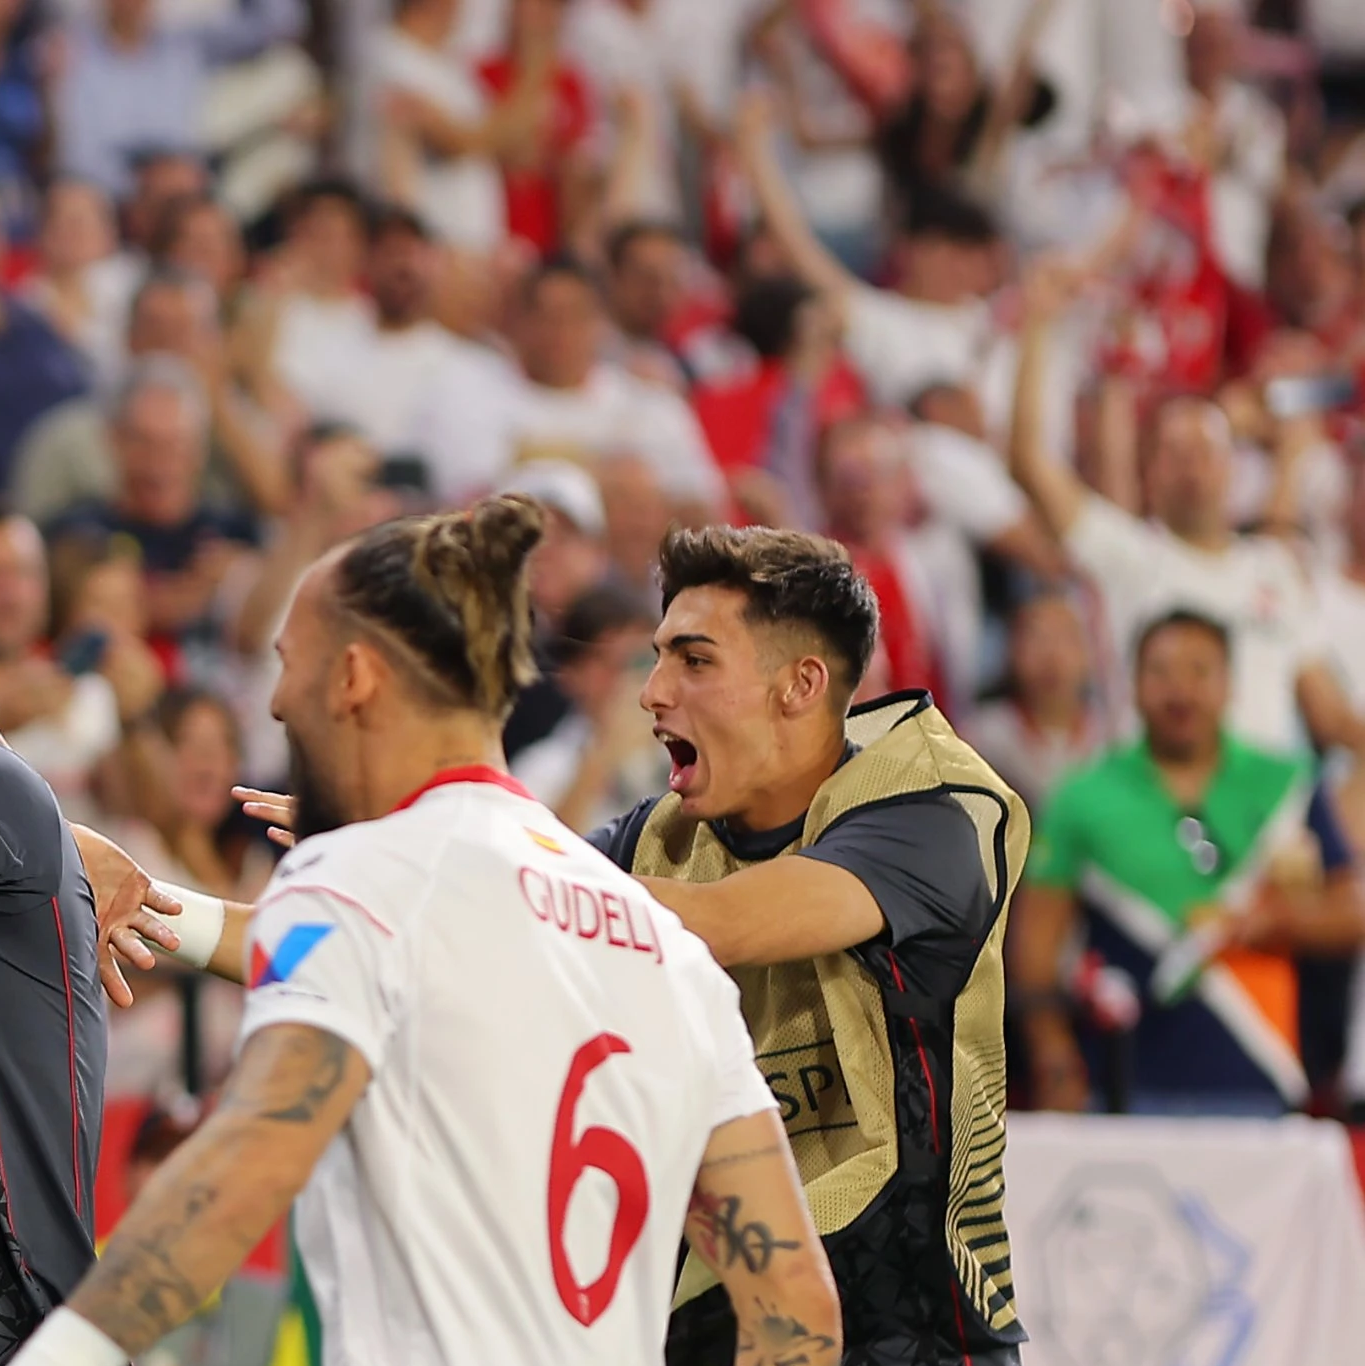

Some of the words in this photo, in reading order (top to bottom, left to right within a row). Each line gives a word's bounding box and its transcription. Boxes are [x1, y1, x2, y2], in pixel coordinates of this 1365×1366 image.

[518, 866, 664, 965] GUDELJ
[765, 1064, 853, 1122] SP
[547, 1031, 650, 1328] 6
